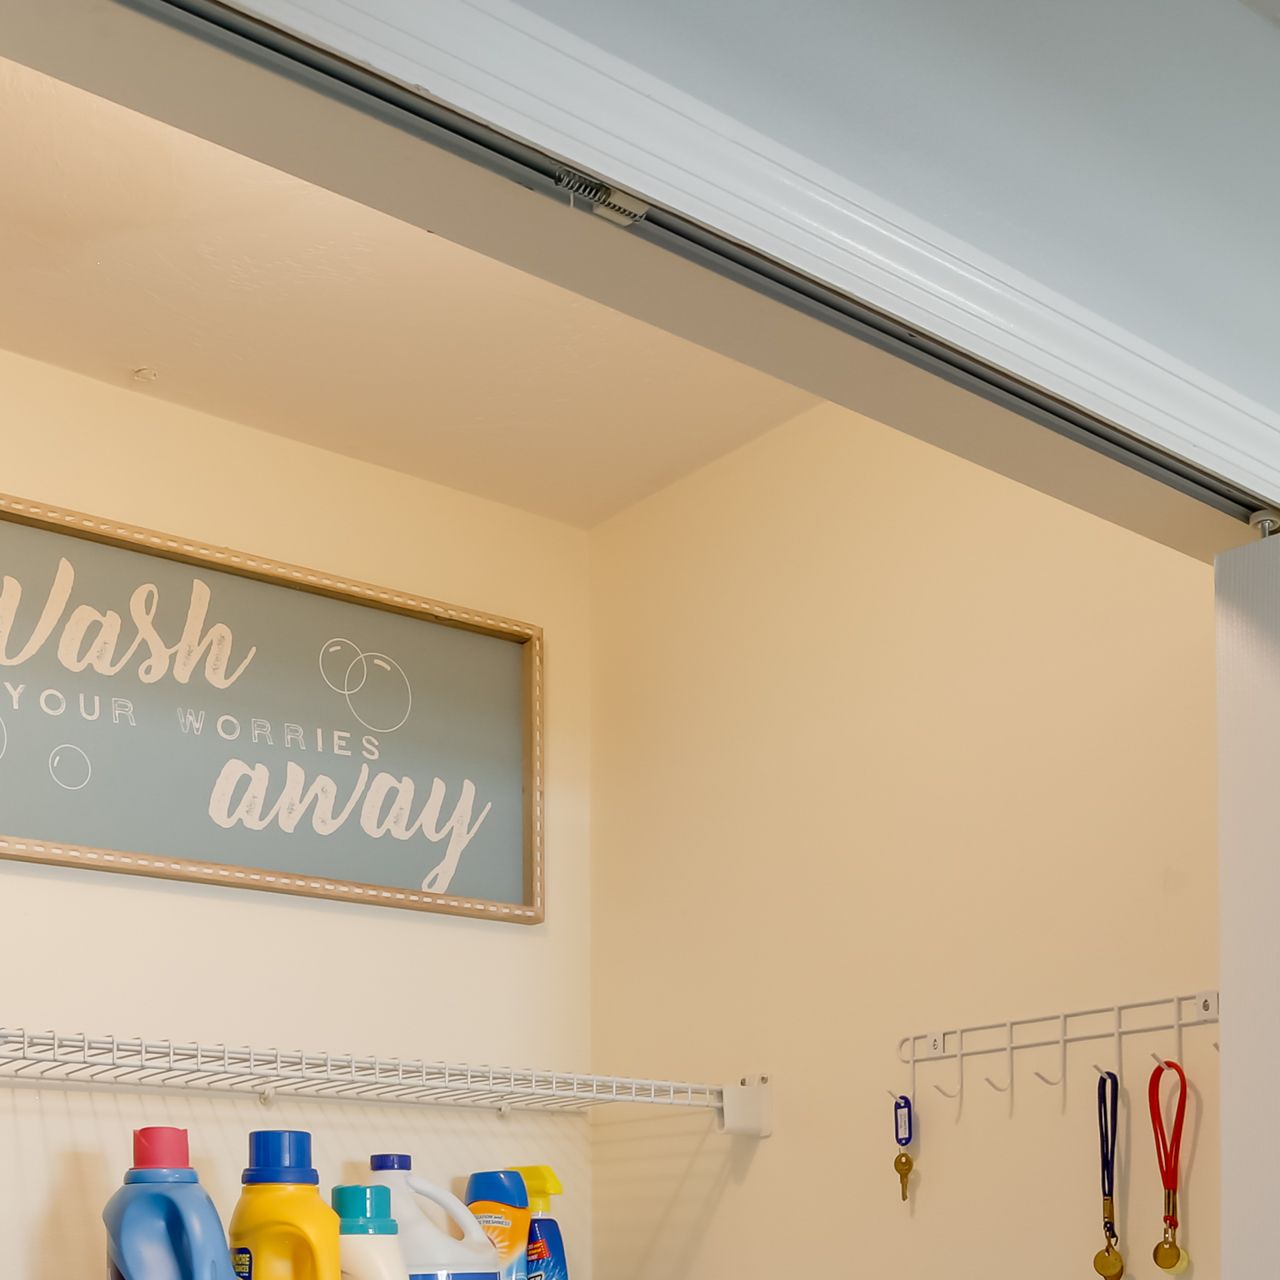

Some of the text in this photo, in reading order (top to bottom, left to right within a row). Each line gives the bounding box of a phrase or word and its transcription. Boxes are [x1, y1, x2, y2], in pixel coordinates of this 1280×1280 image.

[3, 681, 380, 760] YOUR WORRIES
[209, 758, 492, 892] away
